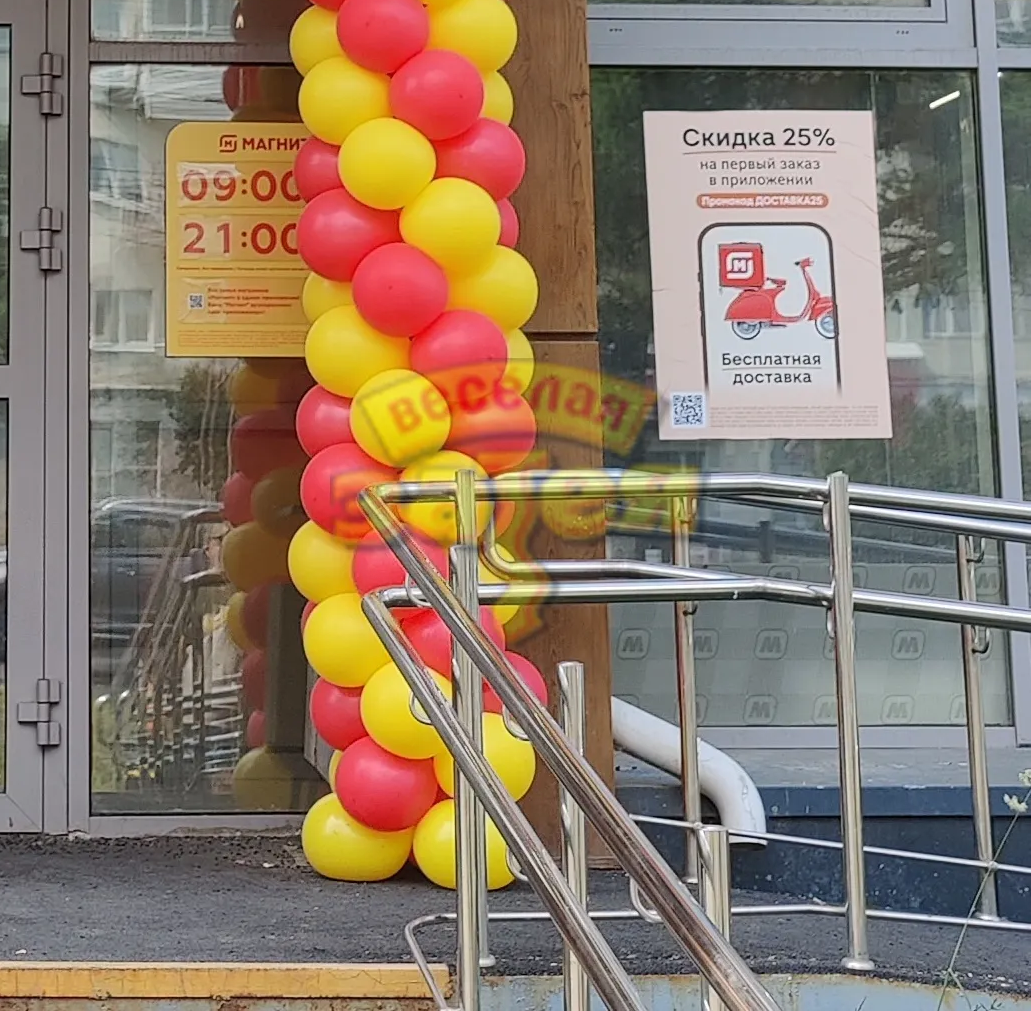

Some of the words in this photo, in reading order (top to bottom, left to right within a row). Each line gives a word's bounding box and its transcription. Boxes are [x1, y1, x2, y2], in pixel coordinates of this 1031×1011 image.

[683, 128, 775, 149] Скидка
[783, 127, 835, 147] 25%
[700, 160, 717, 170] на
[721, 158, 775, 173] первый
[780, 160, 821, 170] заказ
[709, 176, 717, 186] в
[721, 175, 813, 189] приложении
[722, 353, 822, 366] Бесплатная
[732, 372, 812, 385] доставка
